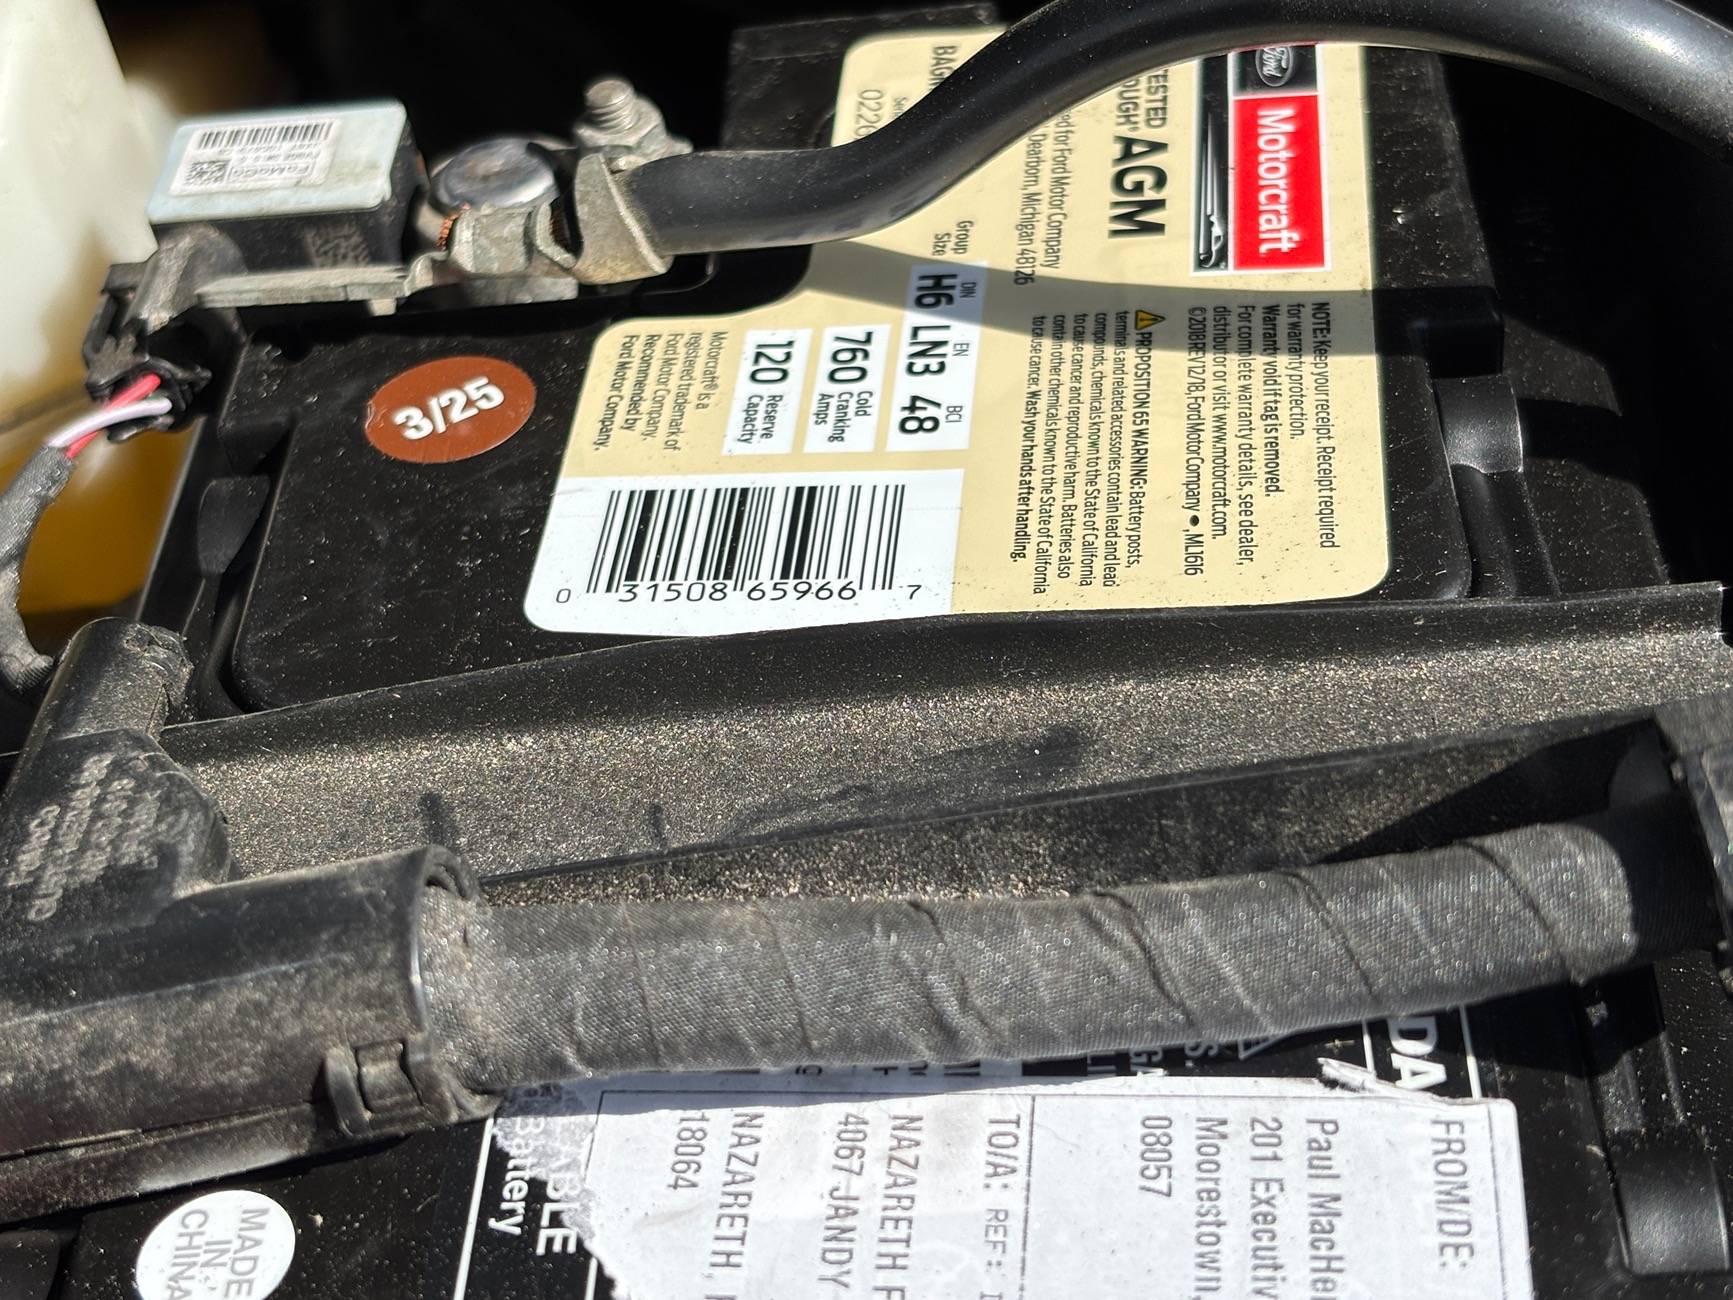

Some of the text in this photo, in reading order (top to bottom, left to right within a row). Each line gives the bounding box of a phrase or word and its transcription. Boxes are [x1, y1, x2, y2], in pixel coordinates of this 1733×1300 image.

[1145, 69, 1169, 129] ESTED
[1262, 47, 1288, 78] Ford
[1051, 148, 1072, 175] Ford
[1053, 130, 1075, 146] for
[1257, 108, 1301, 253] Motorcraft
[1014, 133, 1047, 286] Dearborn, Michigan 48126
[1048, 176, 1071, 211] Motor
[1107, 135, 1169, 239] AGM
[931, 232, 953, 257] Size
[951, 220, 975, 255] Group
[1041, 212, 1068, 269] Company
[592, 335, 641, 452] Ford Motor Company.
[619, 334, 663, 432] Recommended by
[640, 333, 685, 442] Ford Motor Company.
[662, 332, 704, 452] registered trademark of
[695, 331, 729, 410] Motorcraft® is a
[749, 340, 796, 385] 120
[827, 330, 874, 386] 760
[897, 273, 958, 436] H6 LN3 48
[944, 281, 977, 424] DIN EN BCI
[1187, 342, 1207, 364] REV
[1285, 303, 1309, 440] for warranty protection.
[392, 376, 505, 440] 3/25
[736, 394, 765, 445] Capacity
[760, 394, 784, 440] Reserve
[812, 392, 834, 426] Amps
[827, 391, 853, 443] Cranking
[853, 390, 874, 418] Cold
[1010, 316, 1047, 563] to cause cancer. Wash your hands after handling.
[1057, 313, 1089, 580] to cause cancer and reproductive harm. Batteries also
[1185, 422, 1205, 457] Motor
[1186, 396, 1206, 421] Ford
[1211, 305, 1232, 540] distributor or visit www.motorcraft.com.
[1234, 305, 1259, 566] For complete warranty details, see dealer,
[1259, 304, 1285, 498] Warranty void if tag is removed.
[1310, 302, 1341, 549] NOTE: Keep your receipt. Receipt required
[1032, 314, 1067, 595] contain other chemicals known to the State of California
[1079, 312, 1108, 587] compounds, chemicals known to the State of California
[1102, 311, 1131, 588] terminals and related accessories contain lead and lead
[1124, 331, 1154, 569] PROPOSITION 65 WARNING: Battery posts,
[1181, 457, 1205, 512] Company
[555, 580, 922, 604] 0 31508 65966 7
[487, 1117, 547, 1236] Battery
[667, 1111, 710, 1191] 18064
[701, 1112, 765, 1279] NAZARETH,
[874, 1113, 924, 1271] NAZARETH
[983, 1113, 1021, 1190] TO/A:
[1139, 1115, 1173, 1198] 08057
[1430, 1119, 1475, 1269] FROM/DE:
[817, 1112, 870, 1290] 4067 JANDY
[984, 1208, 1009, 1268] REF:
[1249, 1117, 1286, 1300] 201 Executiv
[1305, 1118, 1345, 1300] Paul MacHe
[166, 1208, 210, 1300] CHINA
[200, 1239, 233, 1269] IN
[223, 1207, 271, 1299] MADE
